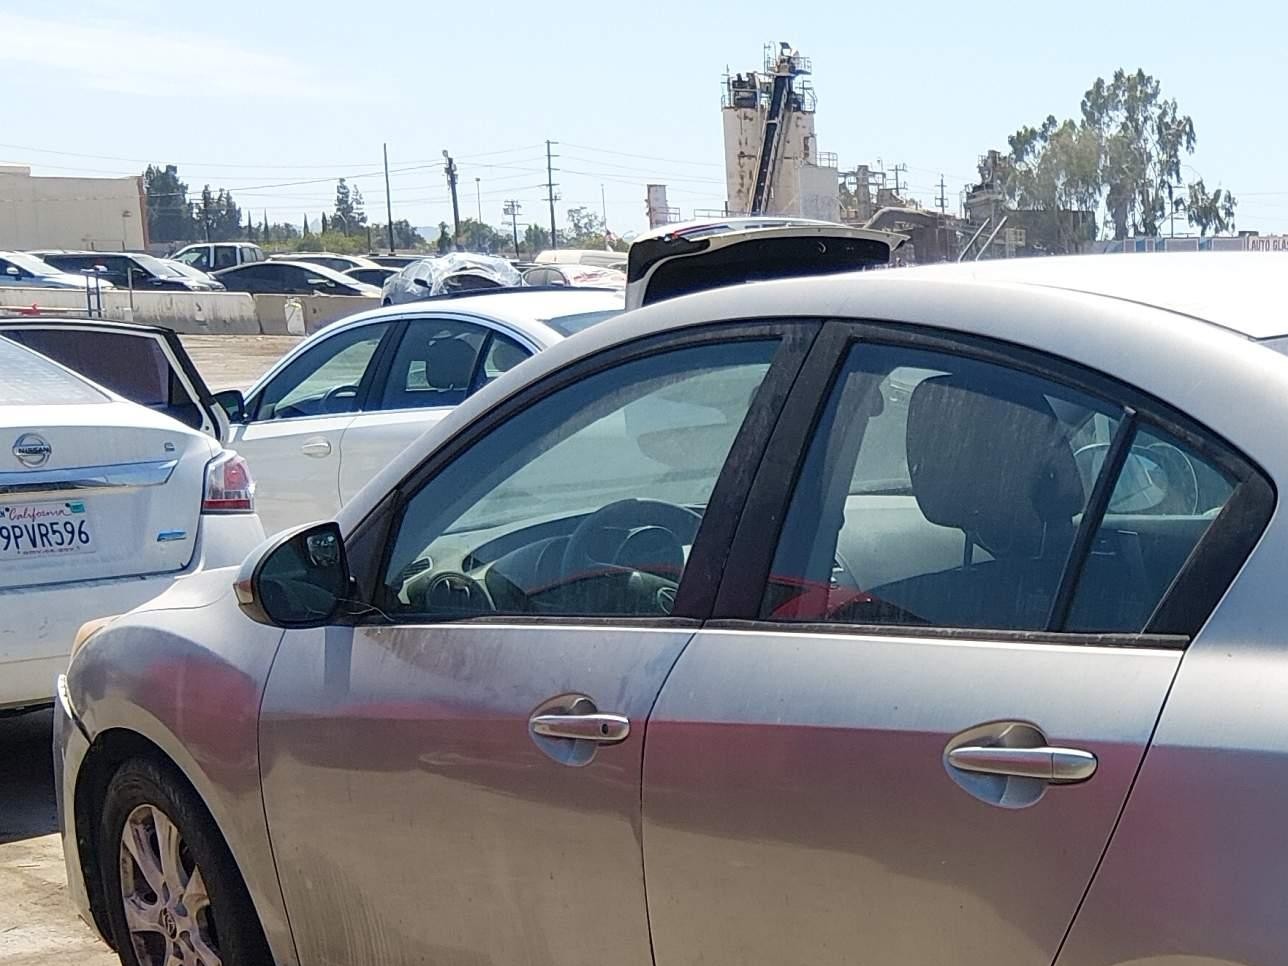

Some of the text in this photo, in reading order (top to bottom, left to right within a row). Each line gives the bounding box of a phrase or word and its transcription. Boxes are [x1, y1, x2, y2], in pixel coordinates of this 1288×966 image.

[1251, 239, 1271, 251] AUTO
[18, 446, 50, 455] NISSAN
[9, 506, 72, 522] California
[0, 519, 90, 551] 9PVR596
